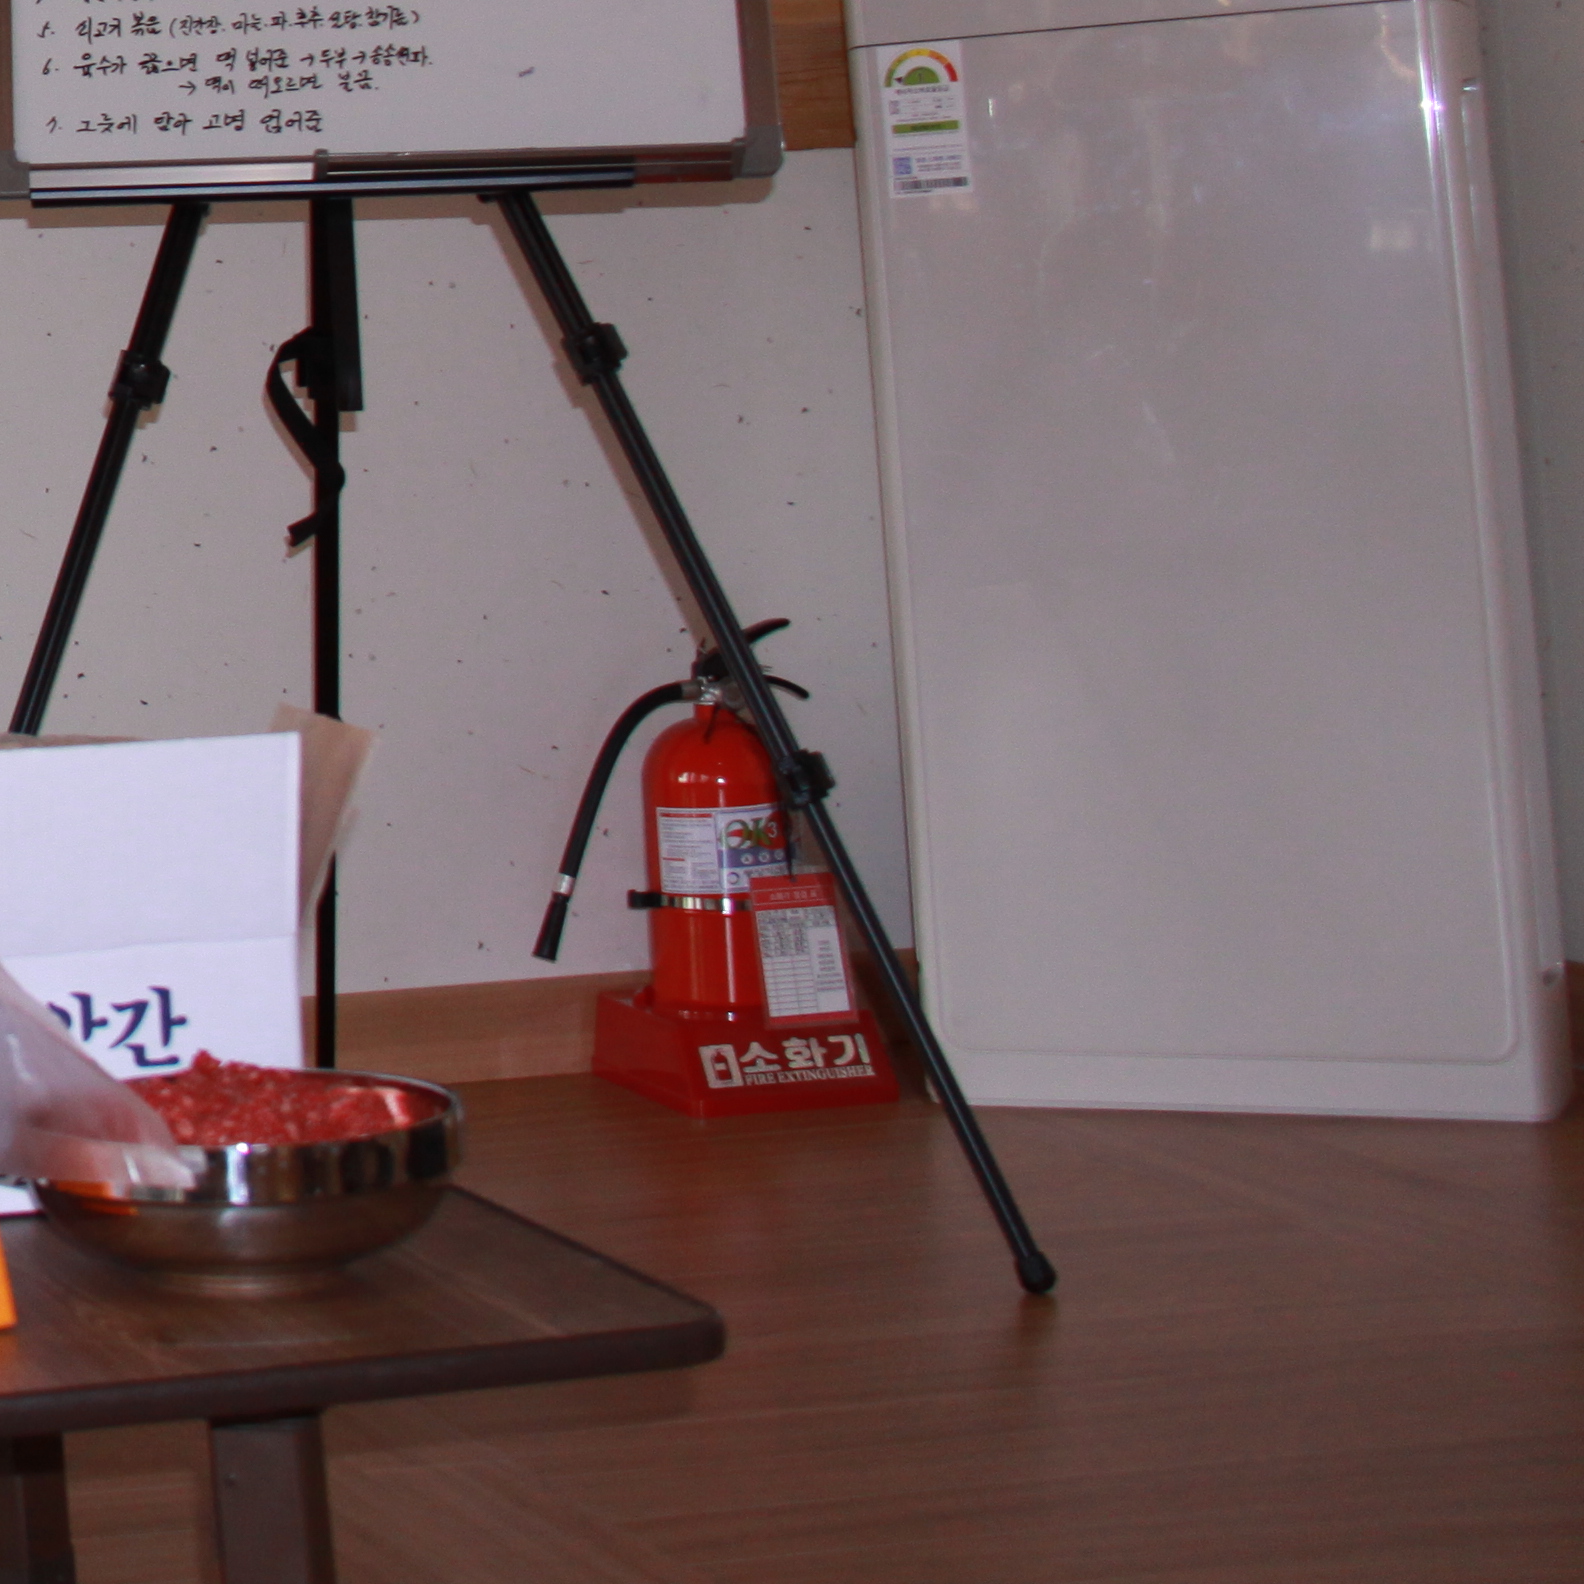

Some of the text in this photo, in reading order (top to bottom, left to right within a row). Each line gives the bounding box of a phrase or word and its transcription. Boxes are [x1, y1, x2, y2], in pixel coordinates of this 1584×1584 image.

[72, 51, 129, 80] 육수가
[214, 46, 238, 73] 떡
[203, 70, 237, 96] 떡이
[247, 68, 324, 100] 떠오르면
[75, 112, 138, 135] 그릇에
[201, 108, 247, 133] 고명
[738, 1032, 870, 1074] 소화기
[744, 1064, 877, 1086] FIRE EXTINGUISHER
